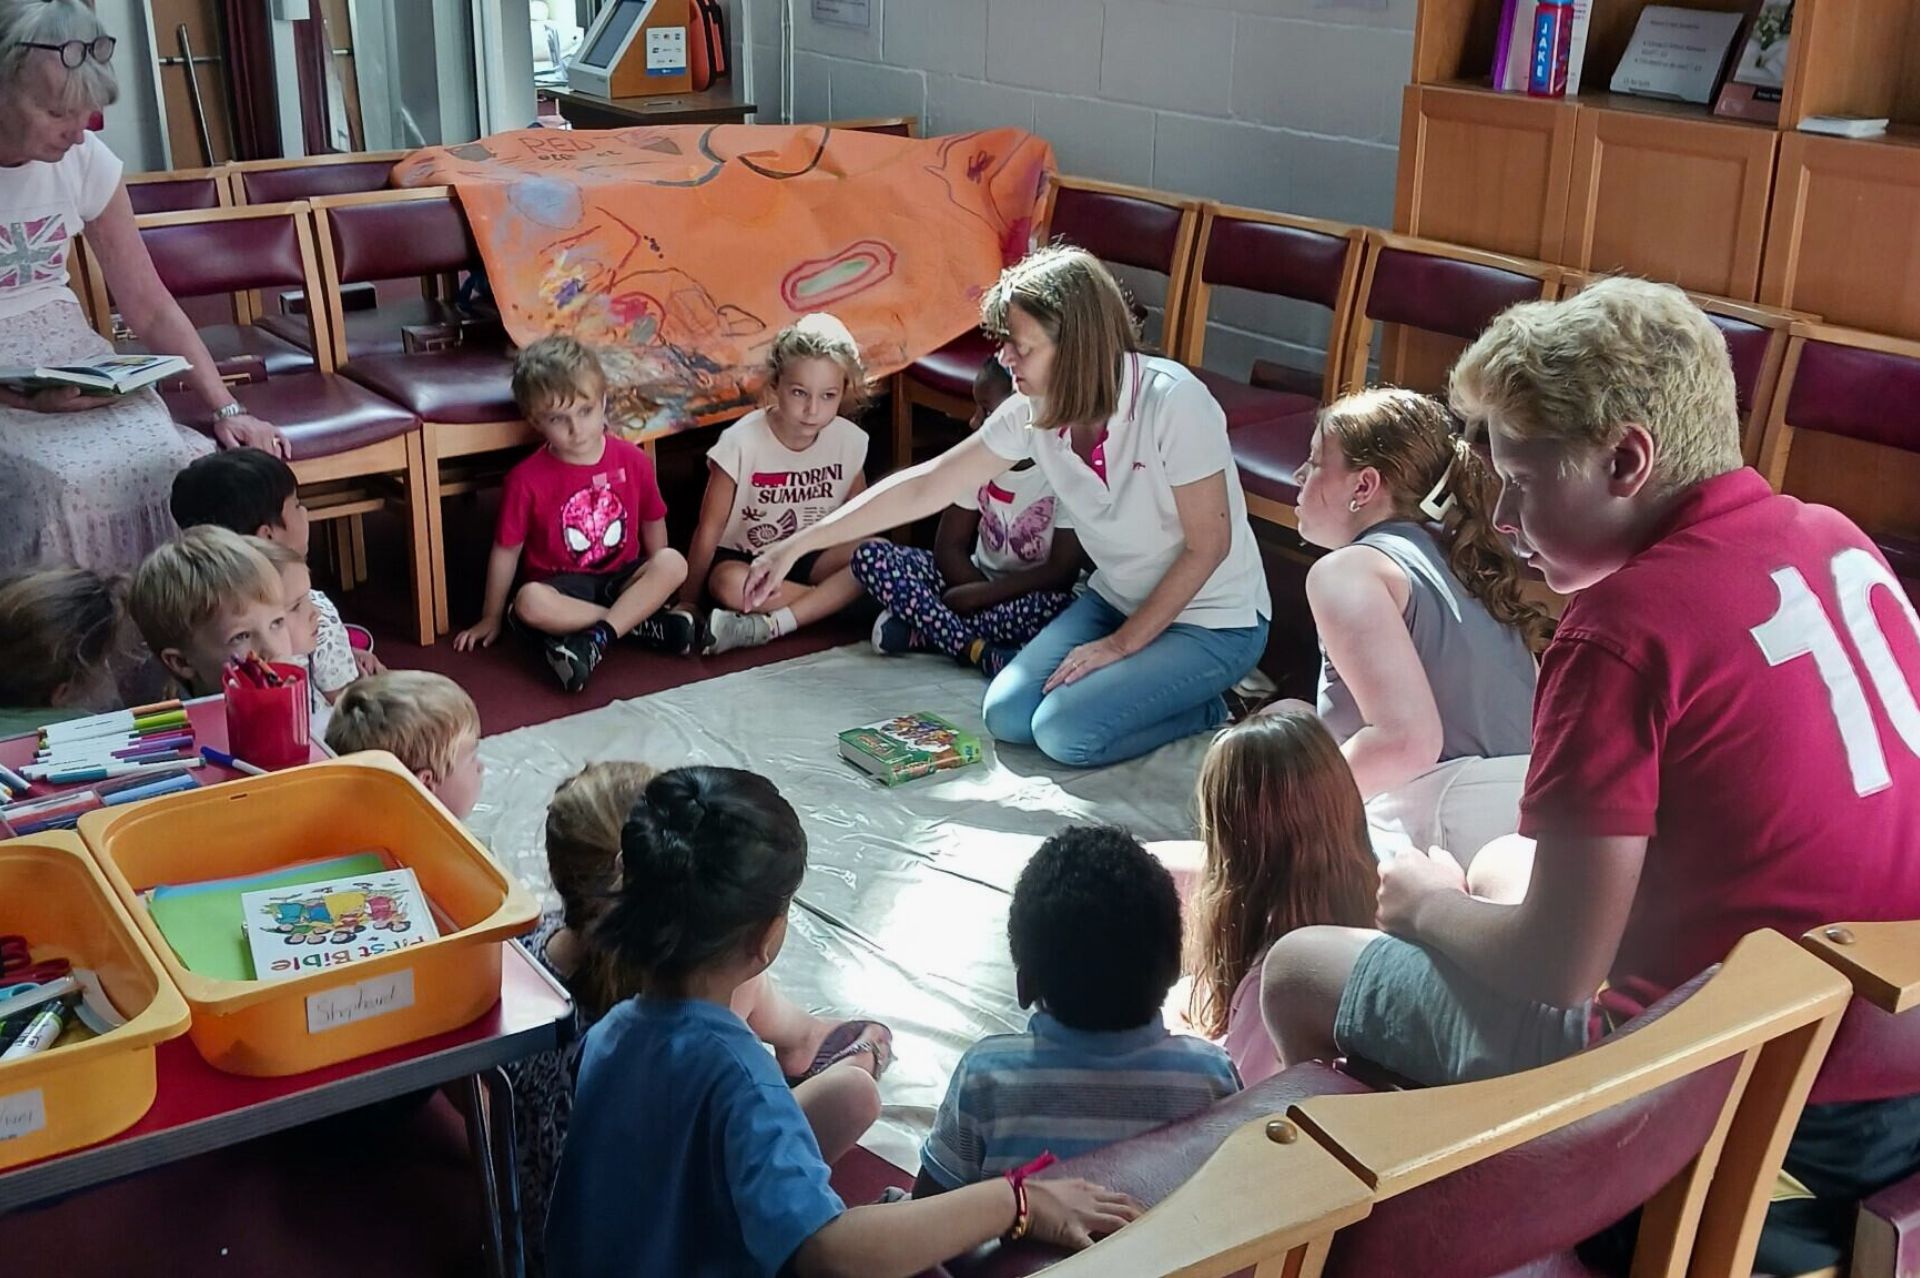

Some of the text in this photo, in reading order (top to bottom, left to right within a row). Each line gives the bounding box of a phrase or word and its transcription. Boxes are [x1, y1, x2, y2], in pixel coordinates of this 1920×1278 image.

[1536, 21, 1548, 78] JAKE
[518, 137, 596, 153] RED
[757, 481, 834, 505] SUMMER
[1749, 546, 1920, 798] 10
[270, 949, 354, 972] Bible
